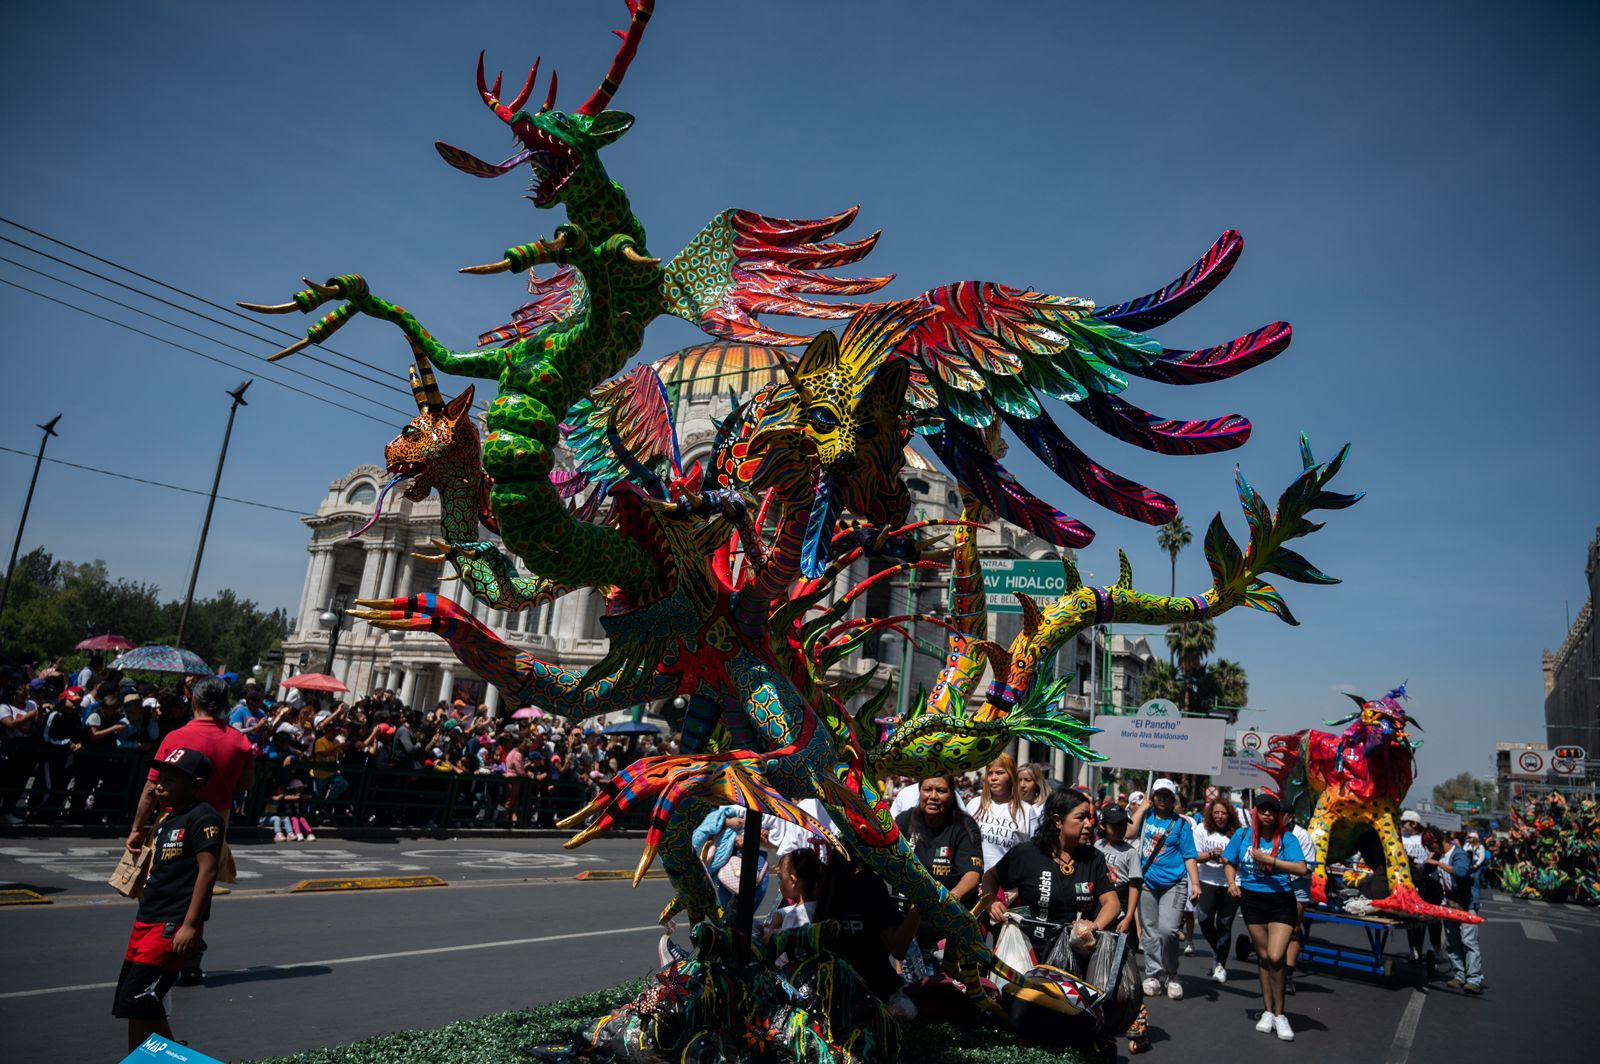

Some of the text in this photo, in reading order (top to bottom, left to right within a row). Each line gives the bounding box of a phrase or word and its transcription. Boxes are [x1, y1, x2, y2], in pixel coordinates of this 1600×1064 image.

[983, 575, 1065, 590] AV HIDALGO
[989, 594, 998, 603] DE
[1001, 595, 1020, 605] BELL
[1145, 719, 1181, 730] Pancho”
[1120, 730, 1138, 738] Mario
[1153, 732, 1189, 740] Maldonado
[982, 833, 1013, 848] PULAR
[142, 1037, 168, 1054] MAP
